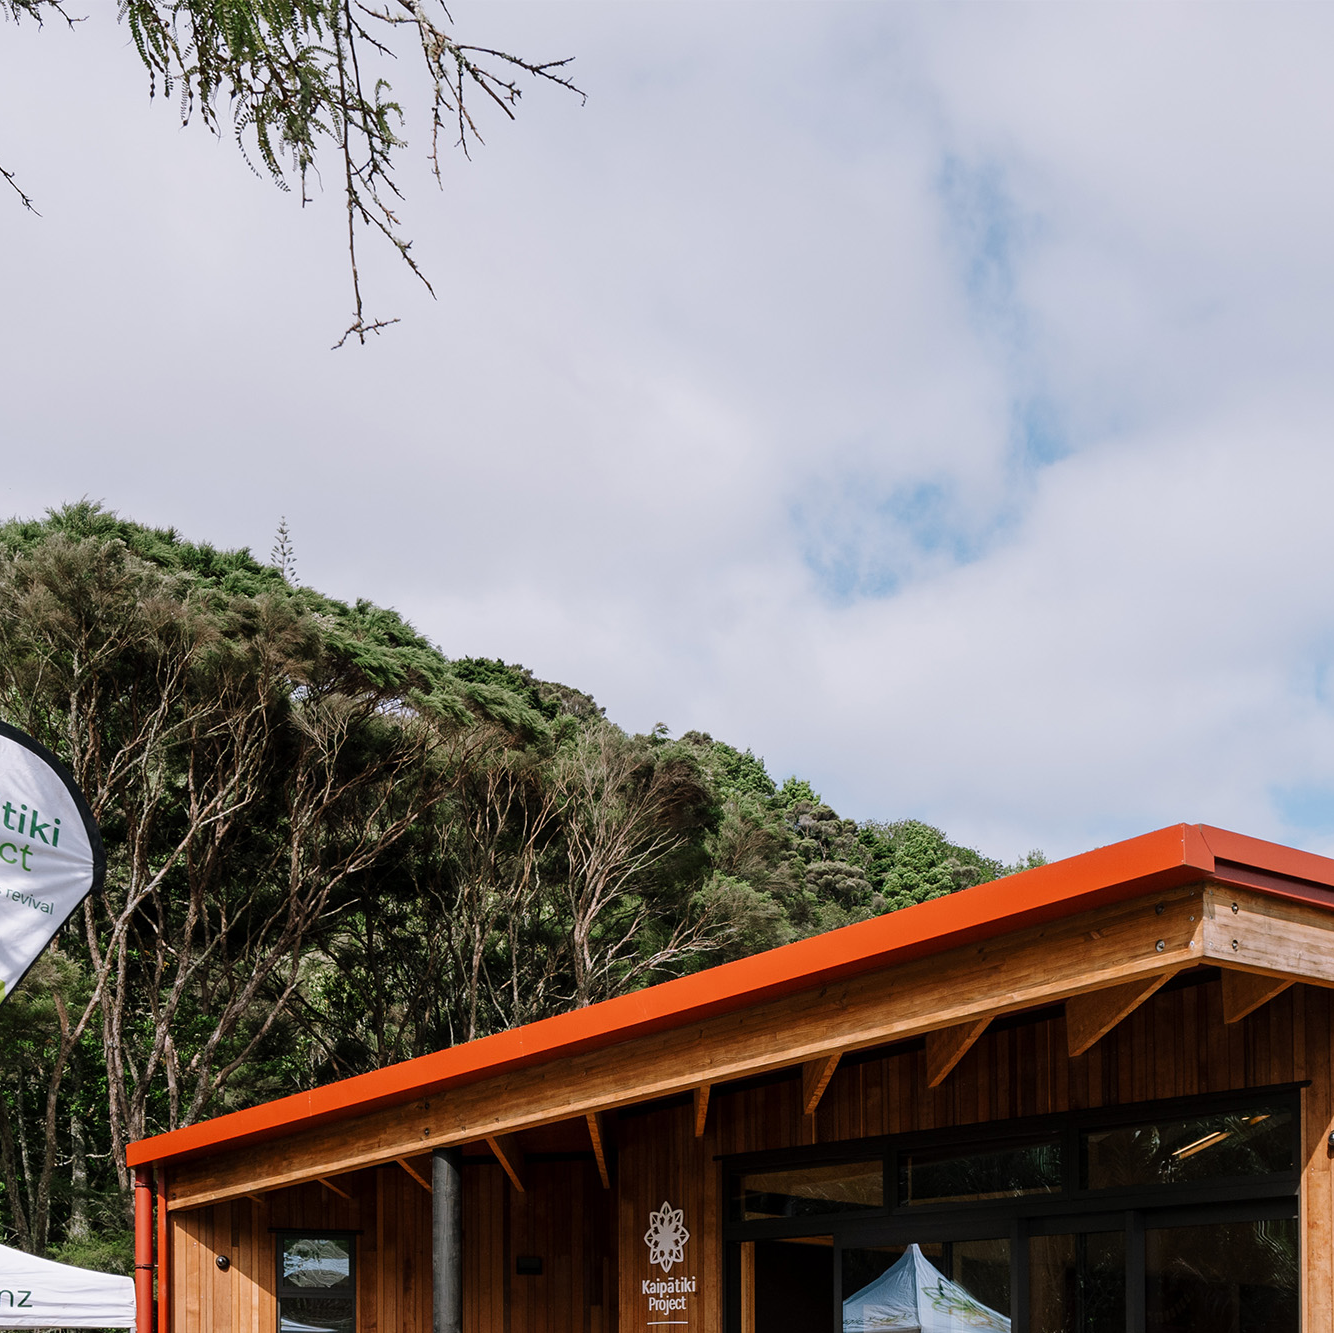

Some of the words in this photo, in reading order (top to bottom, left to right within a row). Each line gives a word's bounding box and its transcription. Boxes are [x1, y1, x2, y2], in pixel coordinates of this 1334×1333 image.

[6, 889, 55, 915] revival
[642, 1276, 696, 1298] Kaipātiki
[648, 1296, 687, 1316] Project
